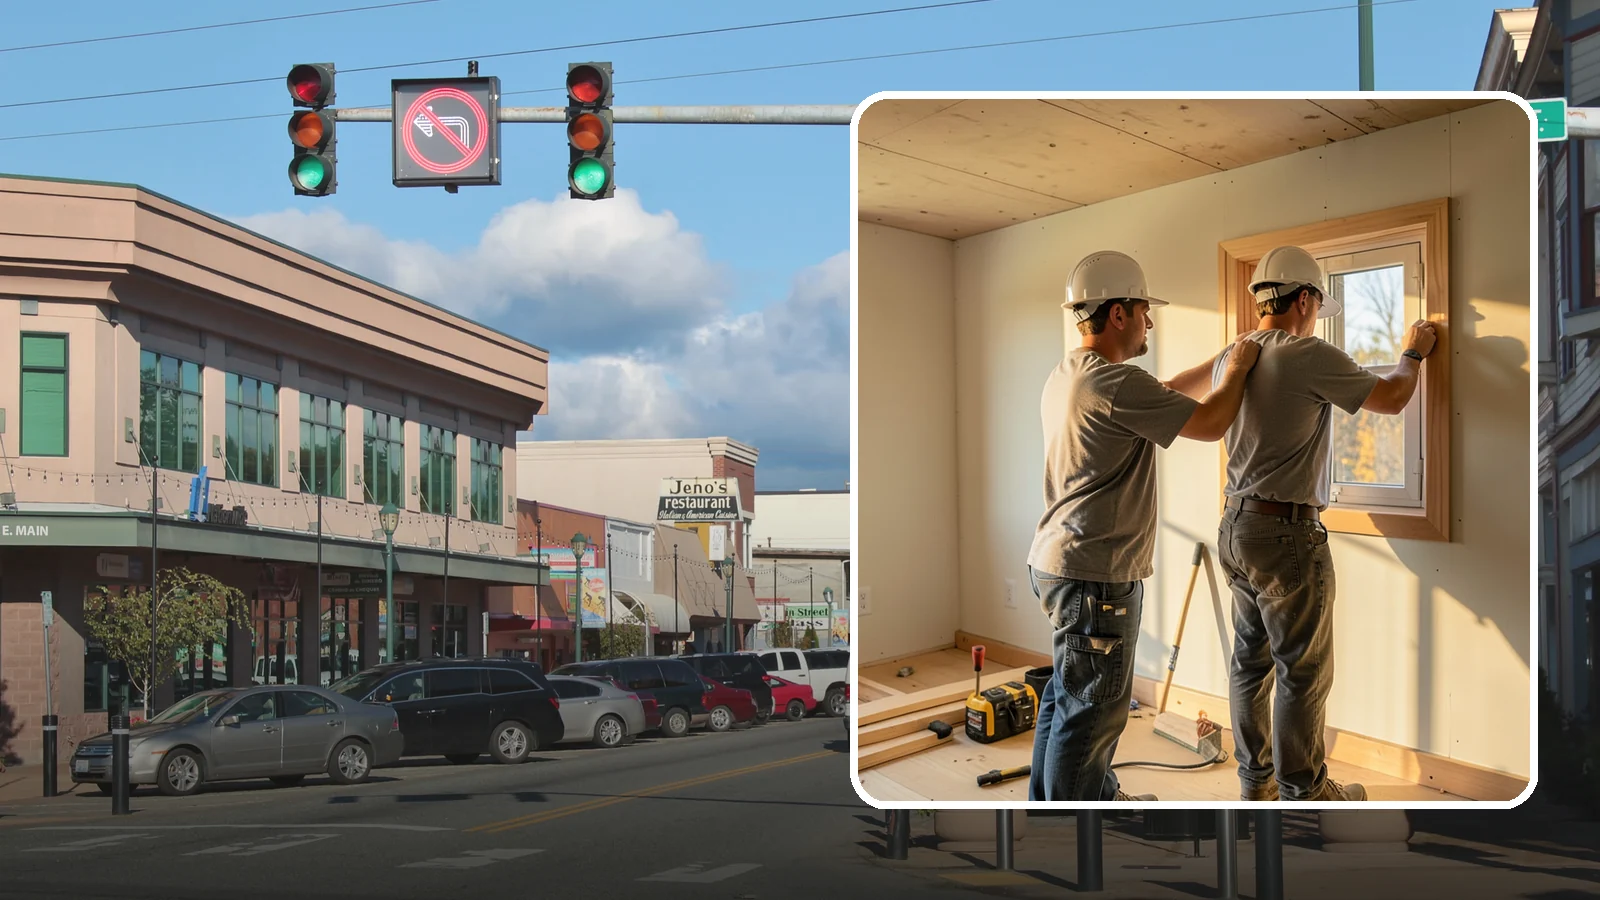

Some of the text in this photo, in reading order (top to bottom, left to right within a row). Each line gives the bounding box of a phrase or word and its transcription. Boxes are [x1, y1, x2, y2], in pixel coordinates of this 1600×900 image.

[669, 480, 728, 494] Jeno's
[665, 496, 731, 509] restaurant
[658, 510, 681, 519] Italian
[686, 510, 714, 519] American
[715, 509, 737, 519] Cuisine
[2, 525, 49, 536] E. MAIN
[797, 607, 828, 617] Street
